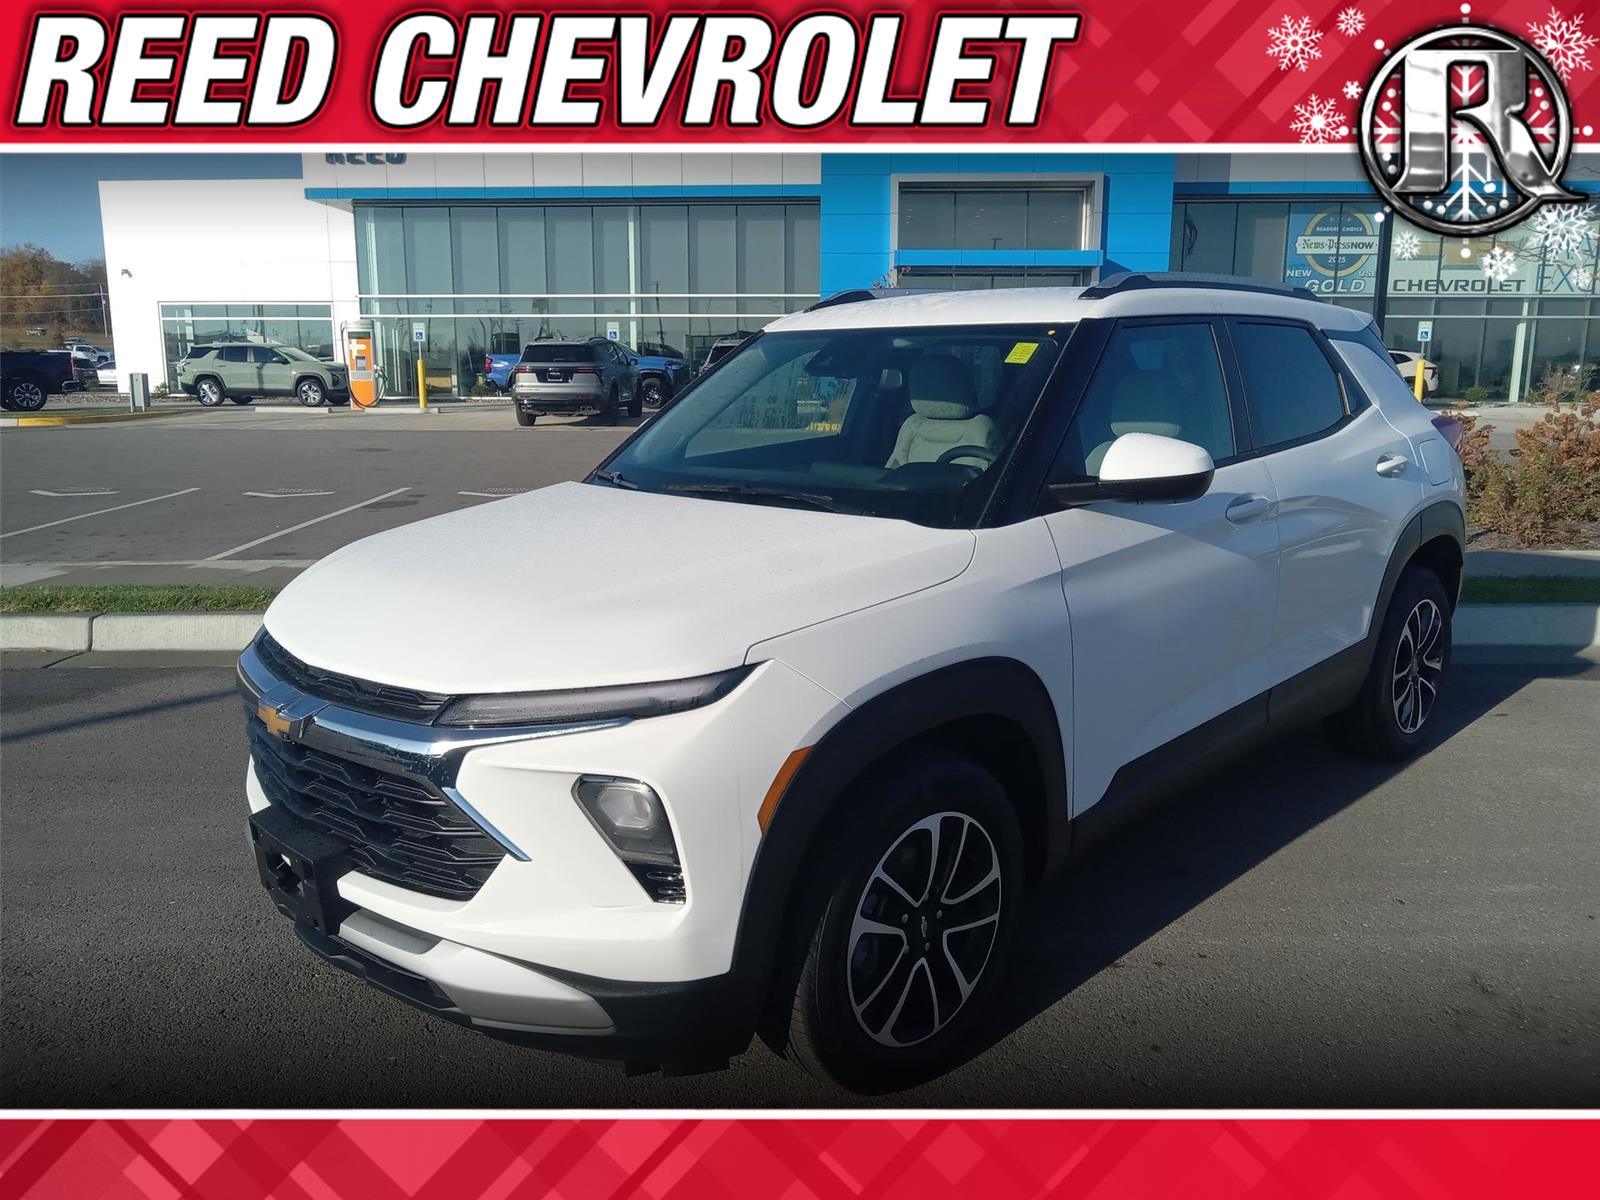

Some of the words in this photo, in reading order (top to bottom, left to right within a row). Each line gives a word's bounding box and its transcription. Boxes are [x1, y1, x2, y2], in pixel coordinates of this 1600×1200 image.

[1286, 269, 1312, 278] NEW
[1304, 279, 1366, 293] GOLD
[1392, 279, 1526, 293] CHEVROLET
